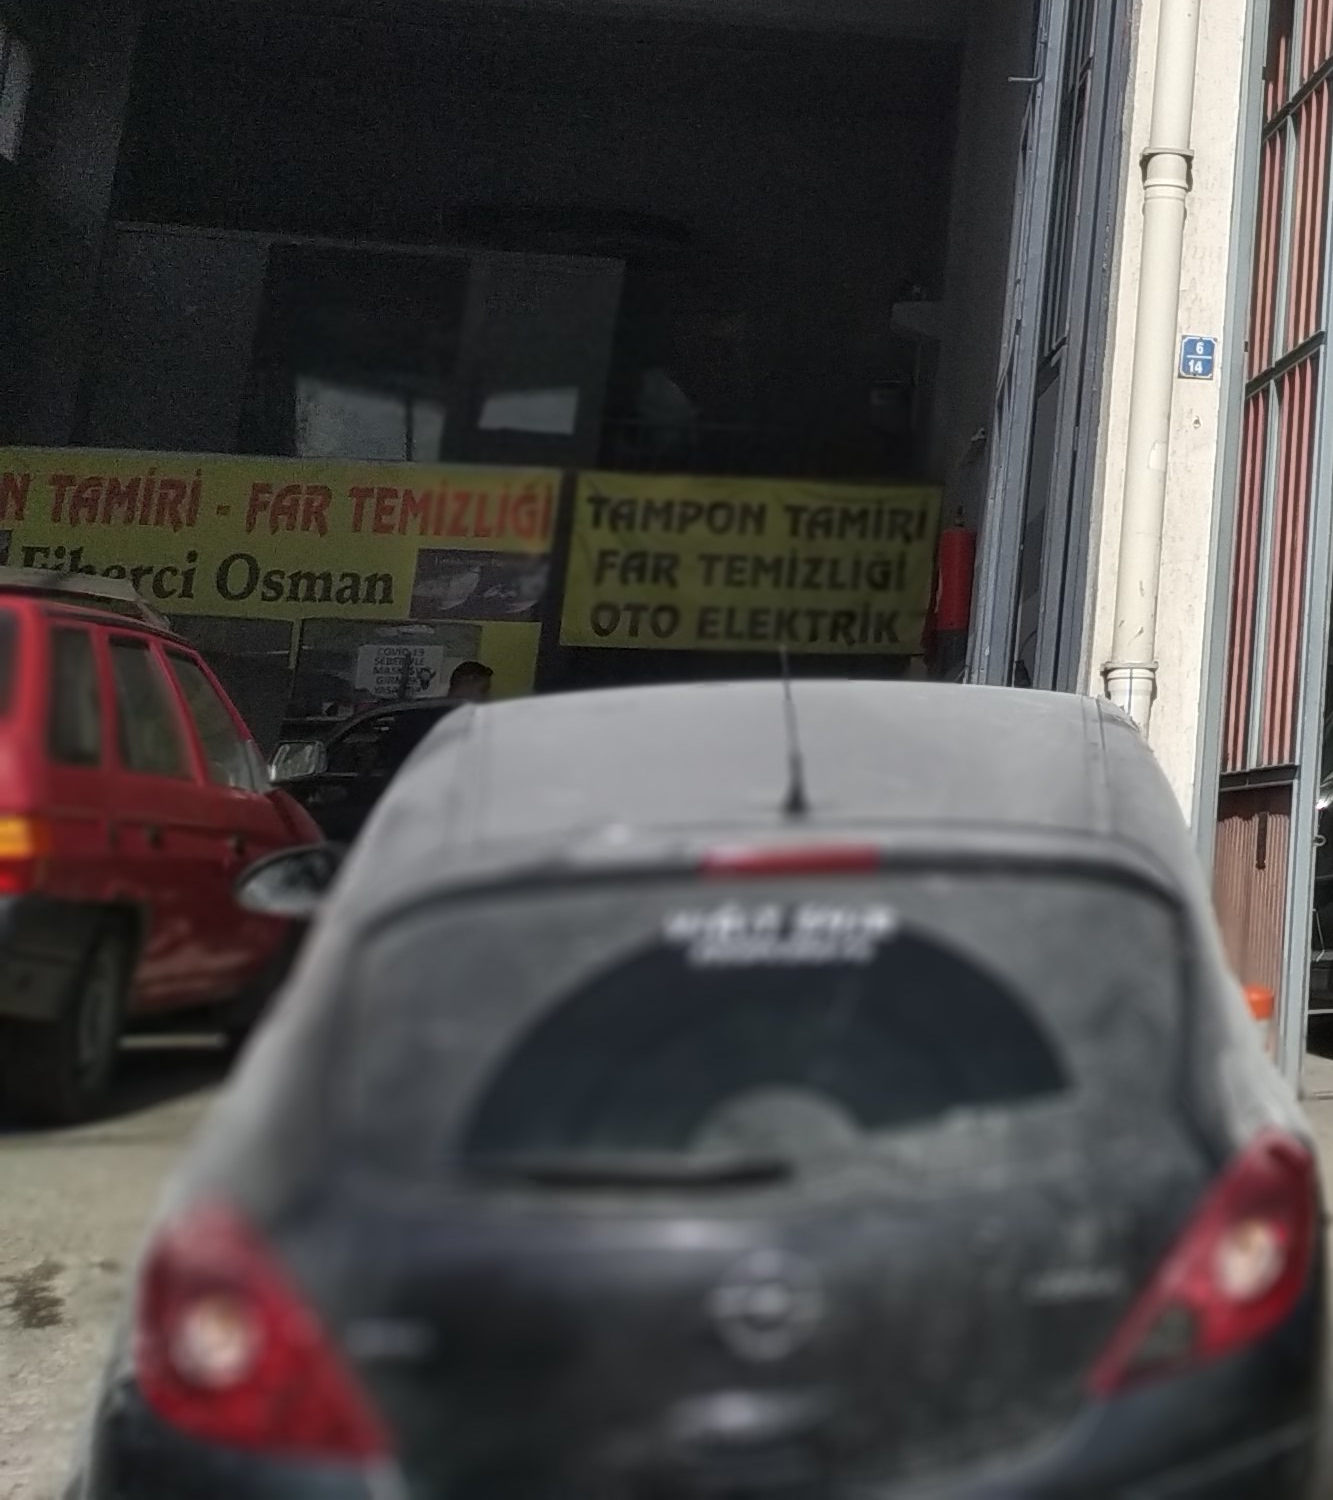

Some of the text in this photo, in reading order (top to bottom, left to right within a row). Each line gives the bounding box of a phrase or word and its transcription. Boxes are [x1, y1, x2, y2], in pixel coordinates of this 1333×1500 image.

[1188, 359, 1203, 374] 14
[1195, 341, 1205, 355] 6
[244, 481, 334, 538] FAR
[586, 494, 768, 538] TAMPON
[215, 551, 395, 605] Osman
[594, 548, 681, 590] FAR
[590, 602, 901, 648] OTO ELEKTRİK
